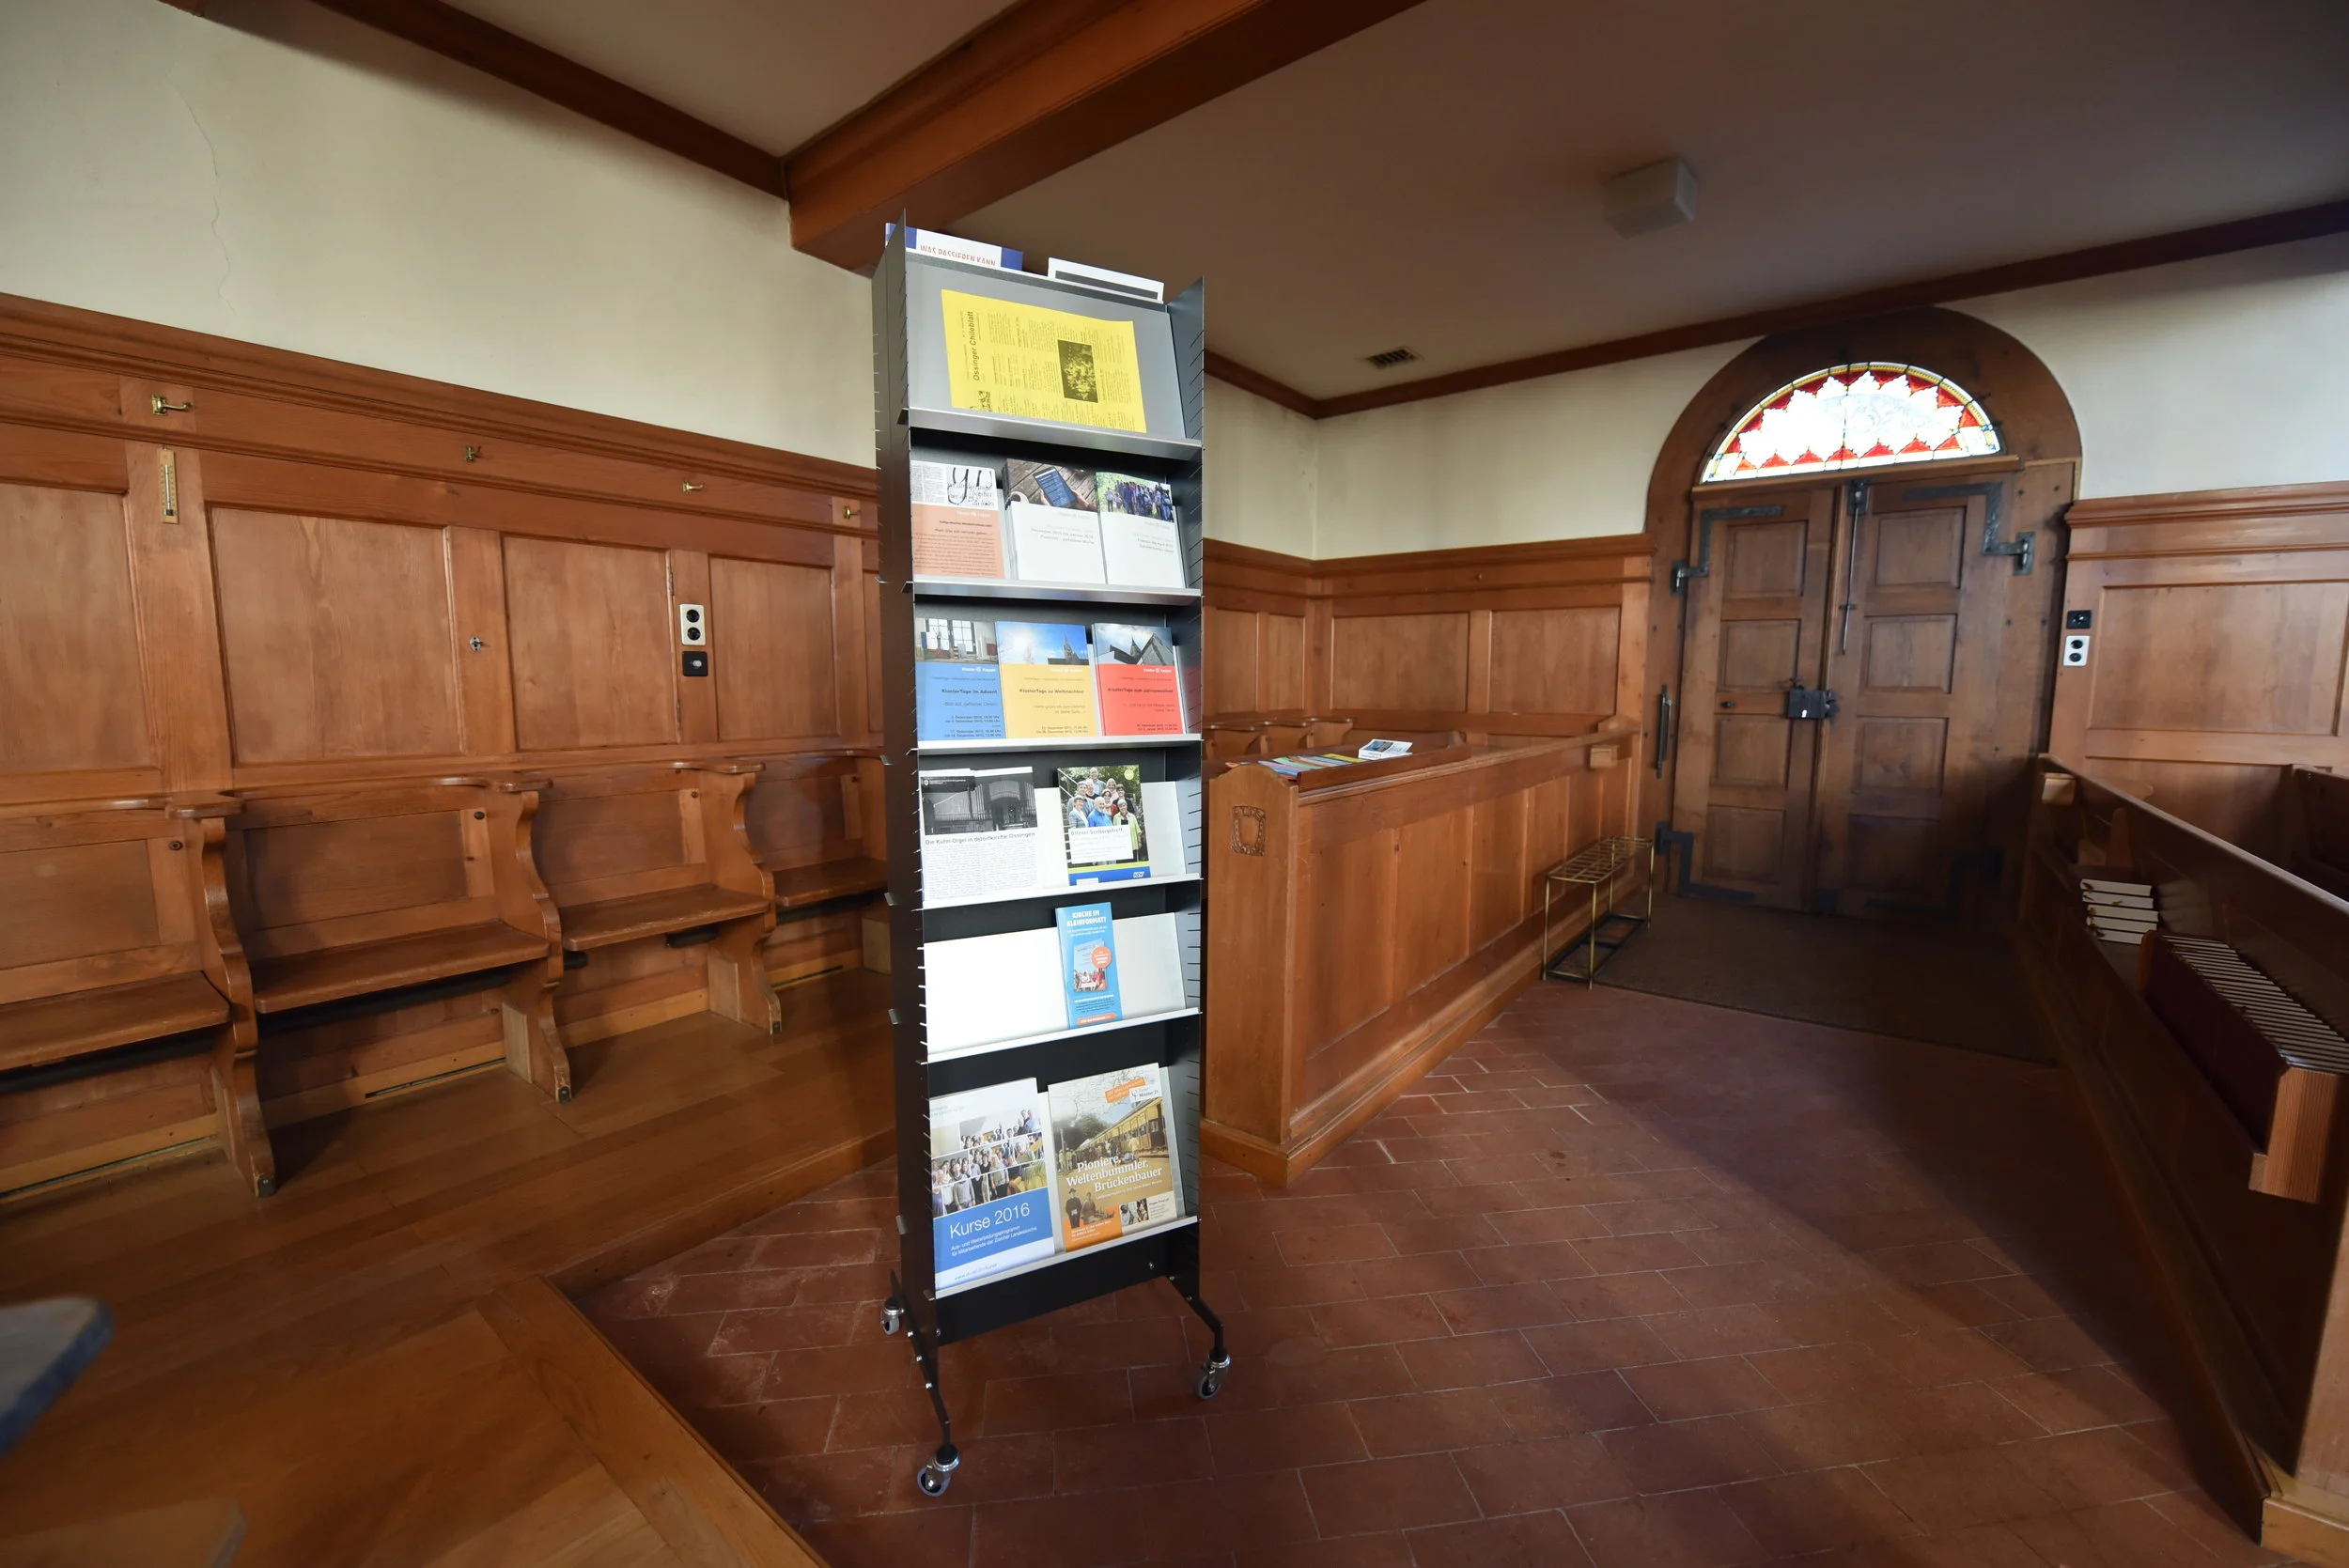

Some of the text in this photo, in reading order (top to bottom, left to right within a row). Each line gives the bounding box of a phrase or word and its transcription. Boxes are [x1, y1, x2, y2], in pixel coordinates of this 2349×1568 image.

[972, 349, 980, 381] Ossinger
[936, 836, 967, 846] Kuhn-Orgel
[1009, 831, 1036, 840] Ossingen
[1072, 910, 1093, 919] KIRCHE
[1066, 1159, 1149, 1187] Weltenbummler,
[1077, 1155, 1122, 1172] Pioniere,
[1094, 1167, 1163, 1192] Brückenbauer
[949, 1202, 1031, 1239] Kurse 2016
